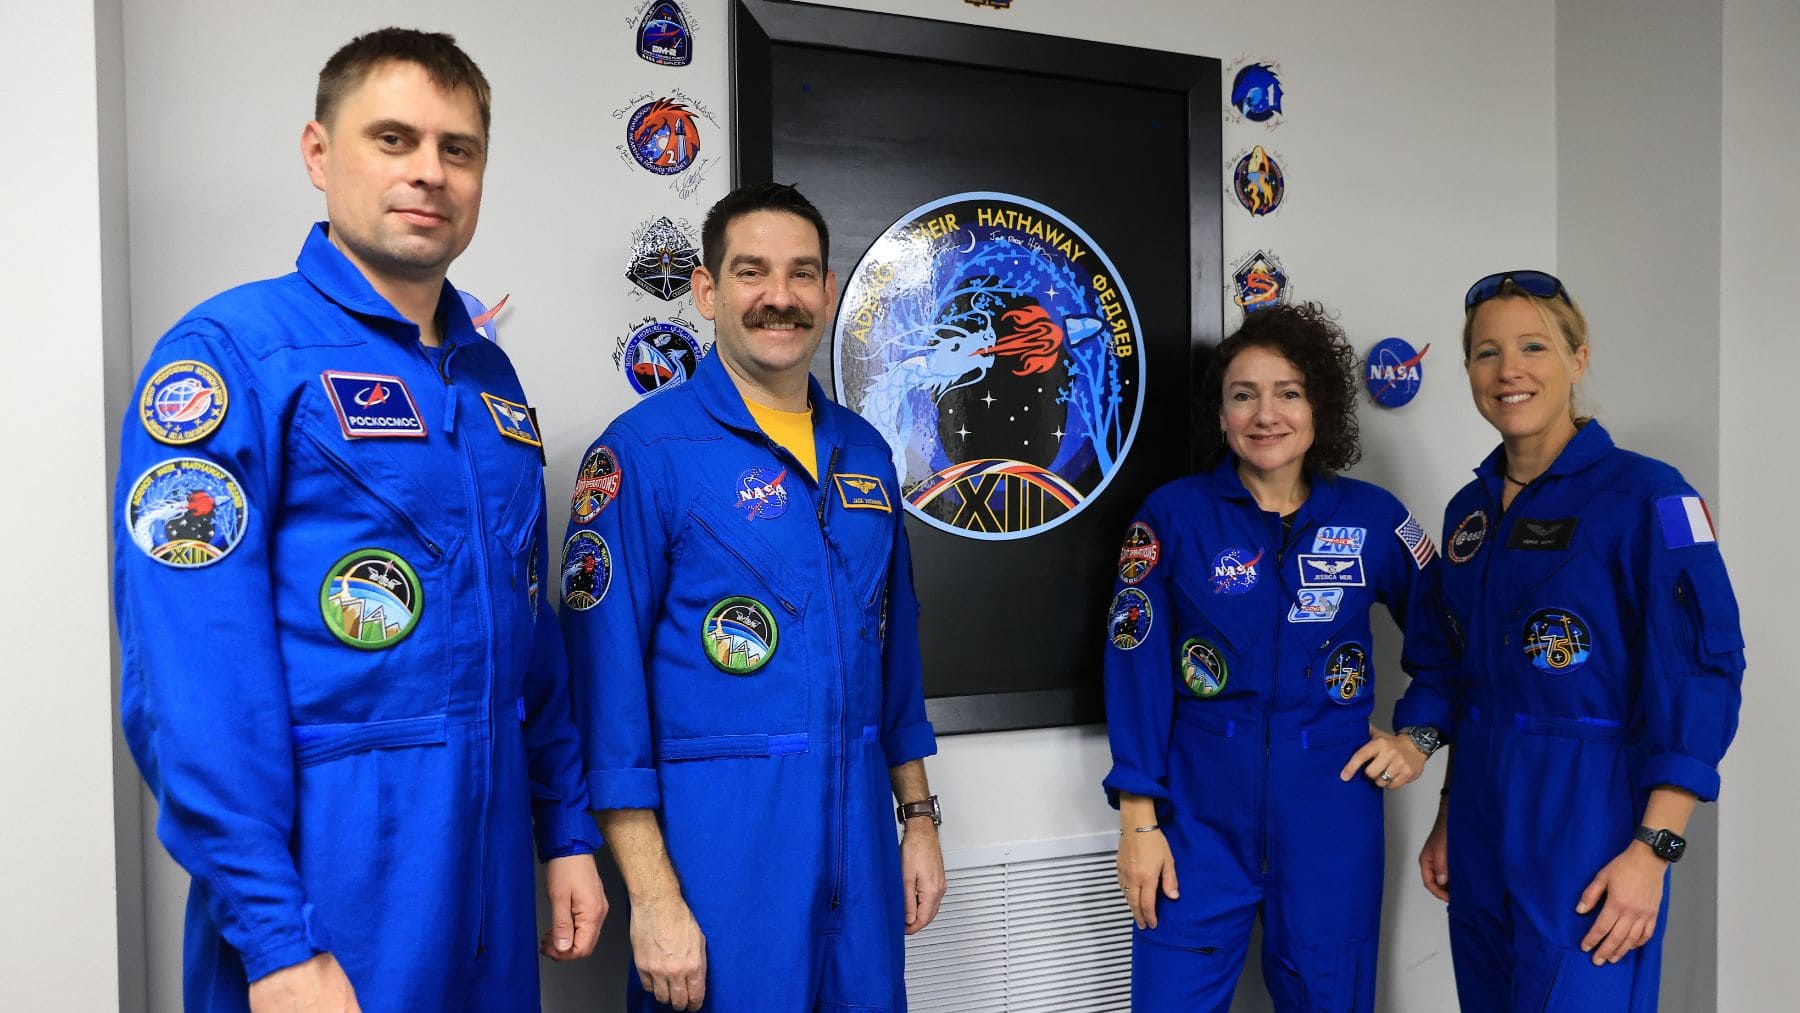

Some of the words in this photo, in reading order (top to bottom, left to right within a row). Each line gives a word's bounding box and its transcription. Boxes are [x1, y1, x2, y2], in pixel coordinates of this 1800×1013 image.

[1267, 83, 1274, 107] 1
[667, 149, 678, 164] 2
[978, 208, 1086, 263] HATHAWAY
[1092, 274, 1132, 357] ФЕДЯЕВ
[1370, 364, 1419, 381] NASA
[349, 416, 418, 427] РОСКОСМОС
[740, 484, 787, 501] NASA
[951, 473, 1044, 533] XII
[1318, 527, 1363, 553] 200
[1215, 565, 1257, 577] NASA
[1294, 592, 1335, 618] 25
[1540, 634, 1571, 668] 75
